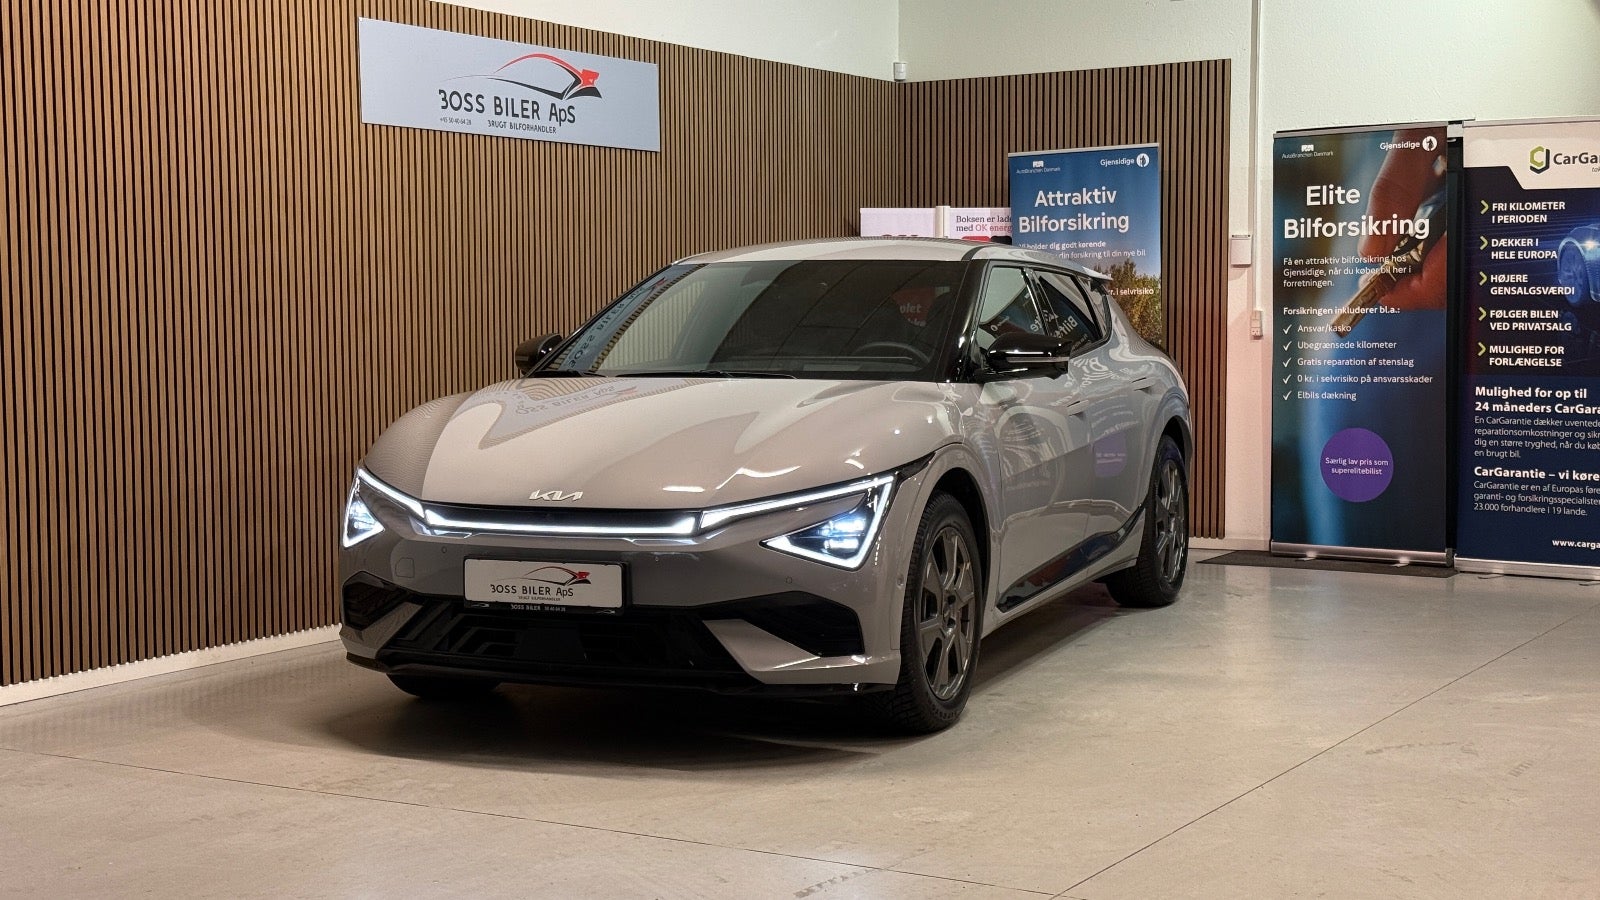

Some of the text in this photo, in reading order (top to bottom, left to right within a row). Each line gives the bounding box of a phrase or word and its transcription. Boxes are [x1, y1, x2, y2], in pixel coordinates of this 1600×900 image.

[494, 96, 540, 120] BILER
[549, 103, 576, 126] ApS
[510, 122, 556, 134] BILFORHANDLER
[1380, 140, 1420, 151] Gjensidige
[1100, 158, 1135, 168] Gjensidige
[1553, 152, 1600, 165] CarGa
[1034, 186, 1117, 207] Attraktiv
[1306, 184, 1360, 206] Elite
[1492, 201, 1566, 211] FRI KILOMETER
[1019, 212, 1129, 233] Bilforsikring
[1498, 214, 1547, 223] PERIODEN
[1284, 214, 1430, 240] Bilforsikring
[1050, 242, 1060, 250] dig
[1061, 242, 1077, 250] godt
[1491, 238, 1539, 247] DÆKKER I
[1071, 251, 1102, 260] forsikring
[1491, 250, 1558, 259] HELE EUROPA
[1283, 257, 1293, 266] Få
[1306, 256, 1340, 265] attraktiv
[1341, 255, 1390, 264] bilforsikring
[1392, 255, 1406, 263] hos
[1283, 268, 1326, 278] Gjensidige,
[1328, 266, 1342, 275] når
[1344, 267, 1353, 275] du
[1355, 266, 1378, 275] køber
[1381, 266, 1390, 274] bil
[1393, 266, 1406, 274] her
[1490, 274, 1528, 283] HØJERE
[1283, 280, 1334, 288] forretningen.
[1120, 287, 1154, 295] selvrisiko
[1490, 287, 1575, 295] GENSALGSVÆRDI
[1283, 307, 1333, 316] Forsikringen
[1334, 306, 1378, 314] inkluderer
[1490, 310, 1558, 318] FØLGER BILEN
[1298, 323, 1352, 333] Ansvar/kasko
[1490, 322, 1572, 331] VED PRIVATSALG
[1298, 340, 1397, 350] Ubegrænsede kilometer
[1489, 345, 1564, 354] MULIGHED FOR
[1298, 358, 1414, 367] Gratis reparation af stenslag
[1489, 358, 1562, 367] FORLÆNGELSE
[1304, 375, 1314, 383] kr.
[1320, 375, 1359, 383] selvrisiko
[1360, 374, 1371, 384] på
[1373, 375, 1433, 383] ansvarsskader
[1322, 392, 1356, 401] dækning
[1475, 386, 1587, 400] Mulighed for op til
[1475, 402, 1489, 411] 24
[1493, 402, 1552, 412] måneders
[1486, 417, 1532, 426] CarGarantie
[1534, 418, 1563, 426] dækker
[1475, 428, 1572, 439] reparationsomkostninger
[1574, 432, 1585, 440] og
[1475, 438, 1487, 447] dig
[1525, 440, 1558, 450] tryghed,
[1560, 441, 1572, 449] når
[1574, 441, 1585, 449] du
[1486, 449, 1508, 459] brugt
[1510, 450, 1521, 458] bil.
[1325, 457, 1347, 466] Særlig
[1360, 458, 1372, 468] pris
[1332, 467, 1382, 475] superelitebilist
[1474, 466, 1546, 479] CarGarantie
[1558, 470, 1569, 480] vi
[1474, 481, 1519, 490] CarGarantie
[1542, 484, 1551, 492] af
[1552, 484, 1584, 494] Europas
[1474, 493, 1504, 501] garanti-
[1474, 503, 1499, 511] 23.000
[1501, 504, 1546, 514] forhandlere
[1564, 506, 1587, 516] lande.
[522, 586, 551, 596] BILER
[556, 587, 574, 598] ApS
